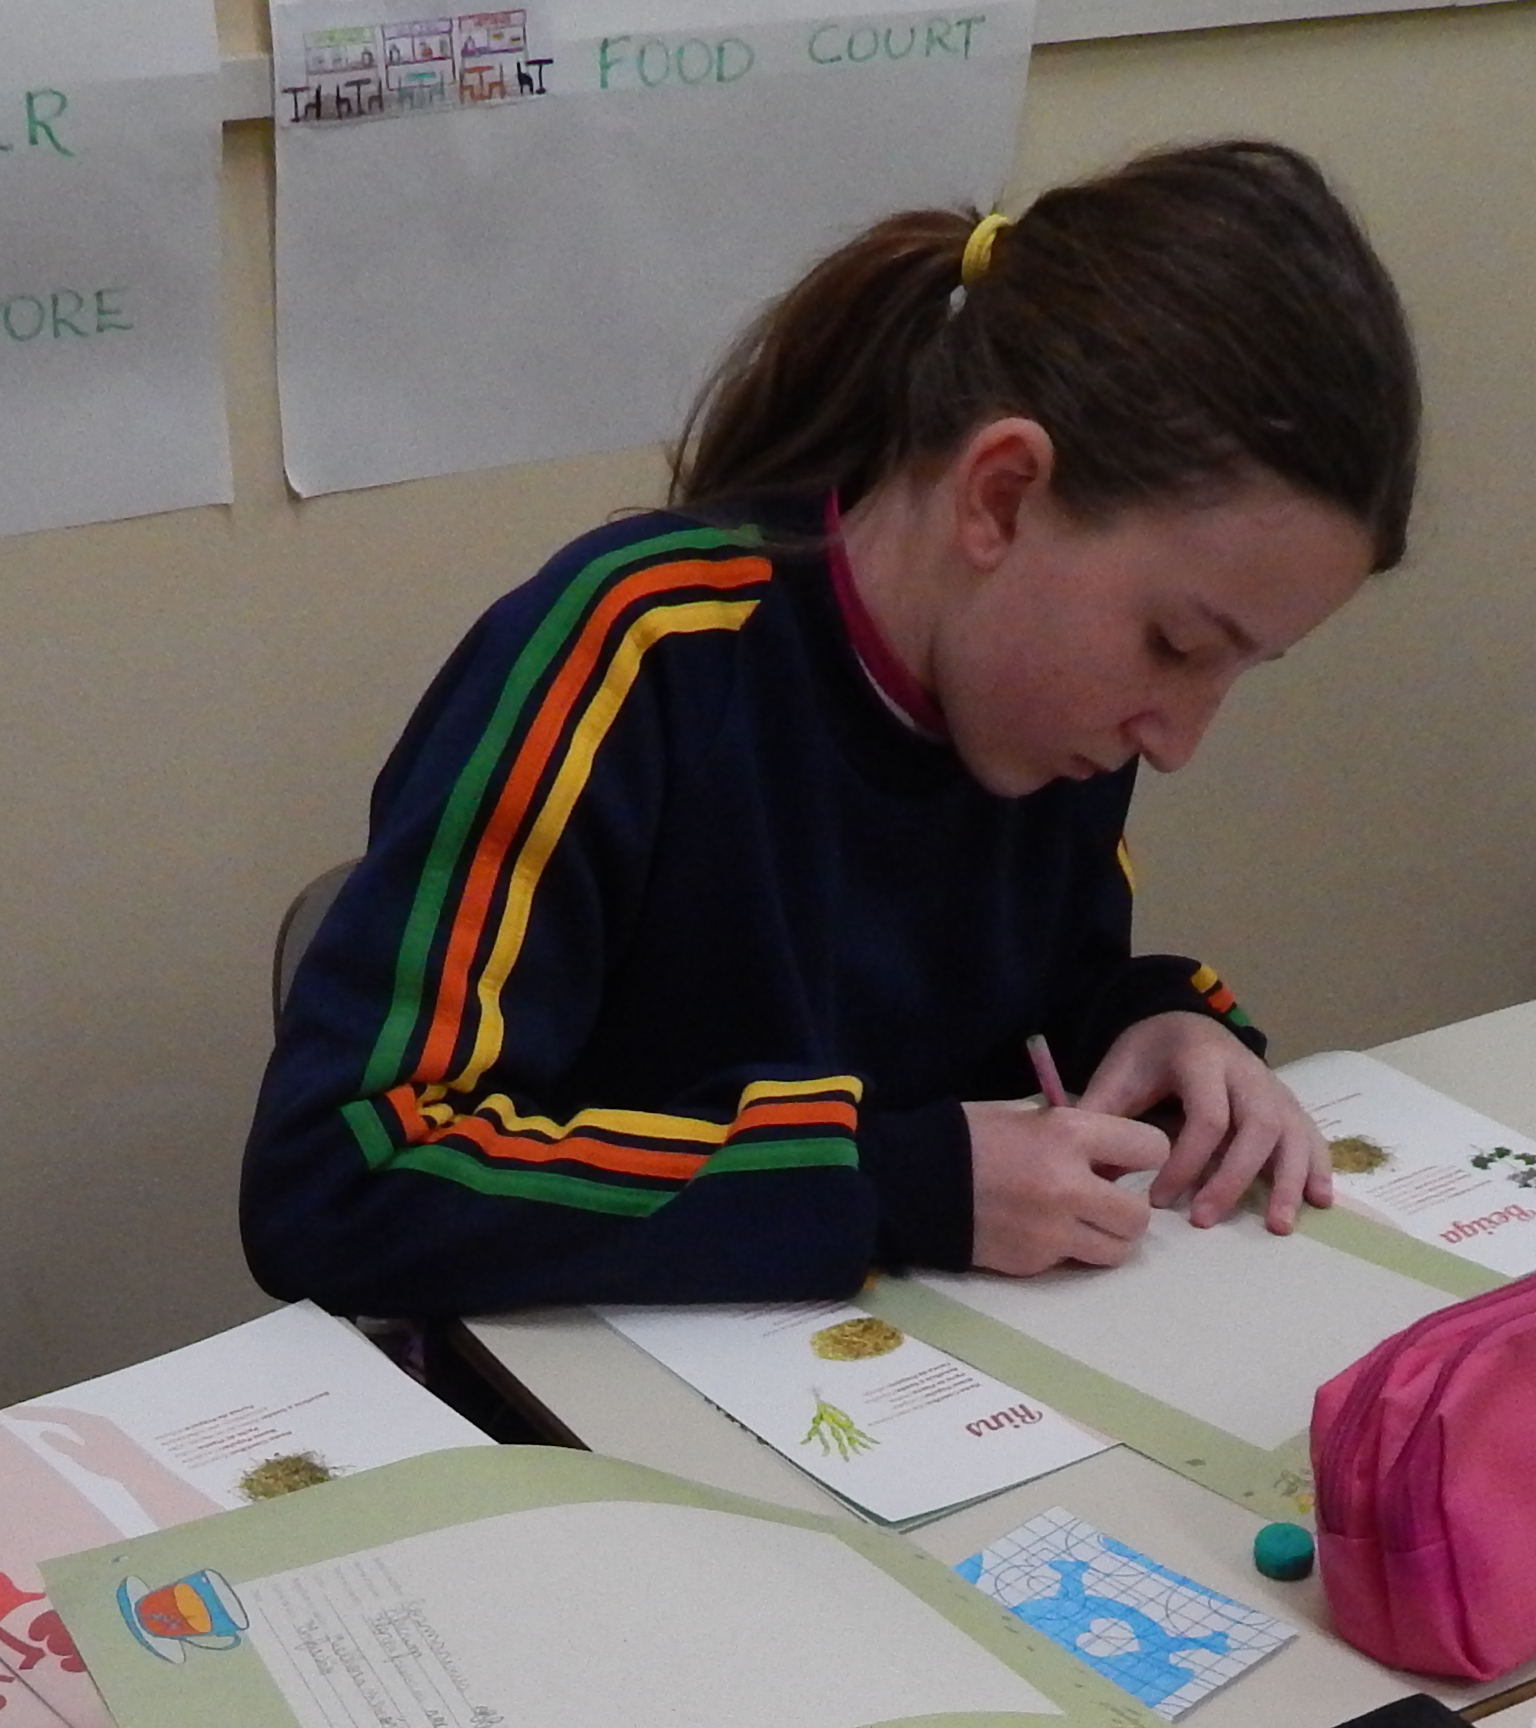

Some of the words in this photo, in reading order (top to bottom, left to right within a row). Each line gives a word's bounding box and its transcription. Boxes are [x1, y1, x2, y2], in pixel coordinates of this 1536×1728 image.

[598, 35, 755, 90] FOOD
[808, 15, 987, 68] COURT
[965, 1402, 1045, 1439] Rins
